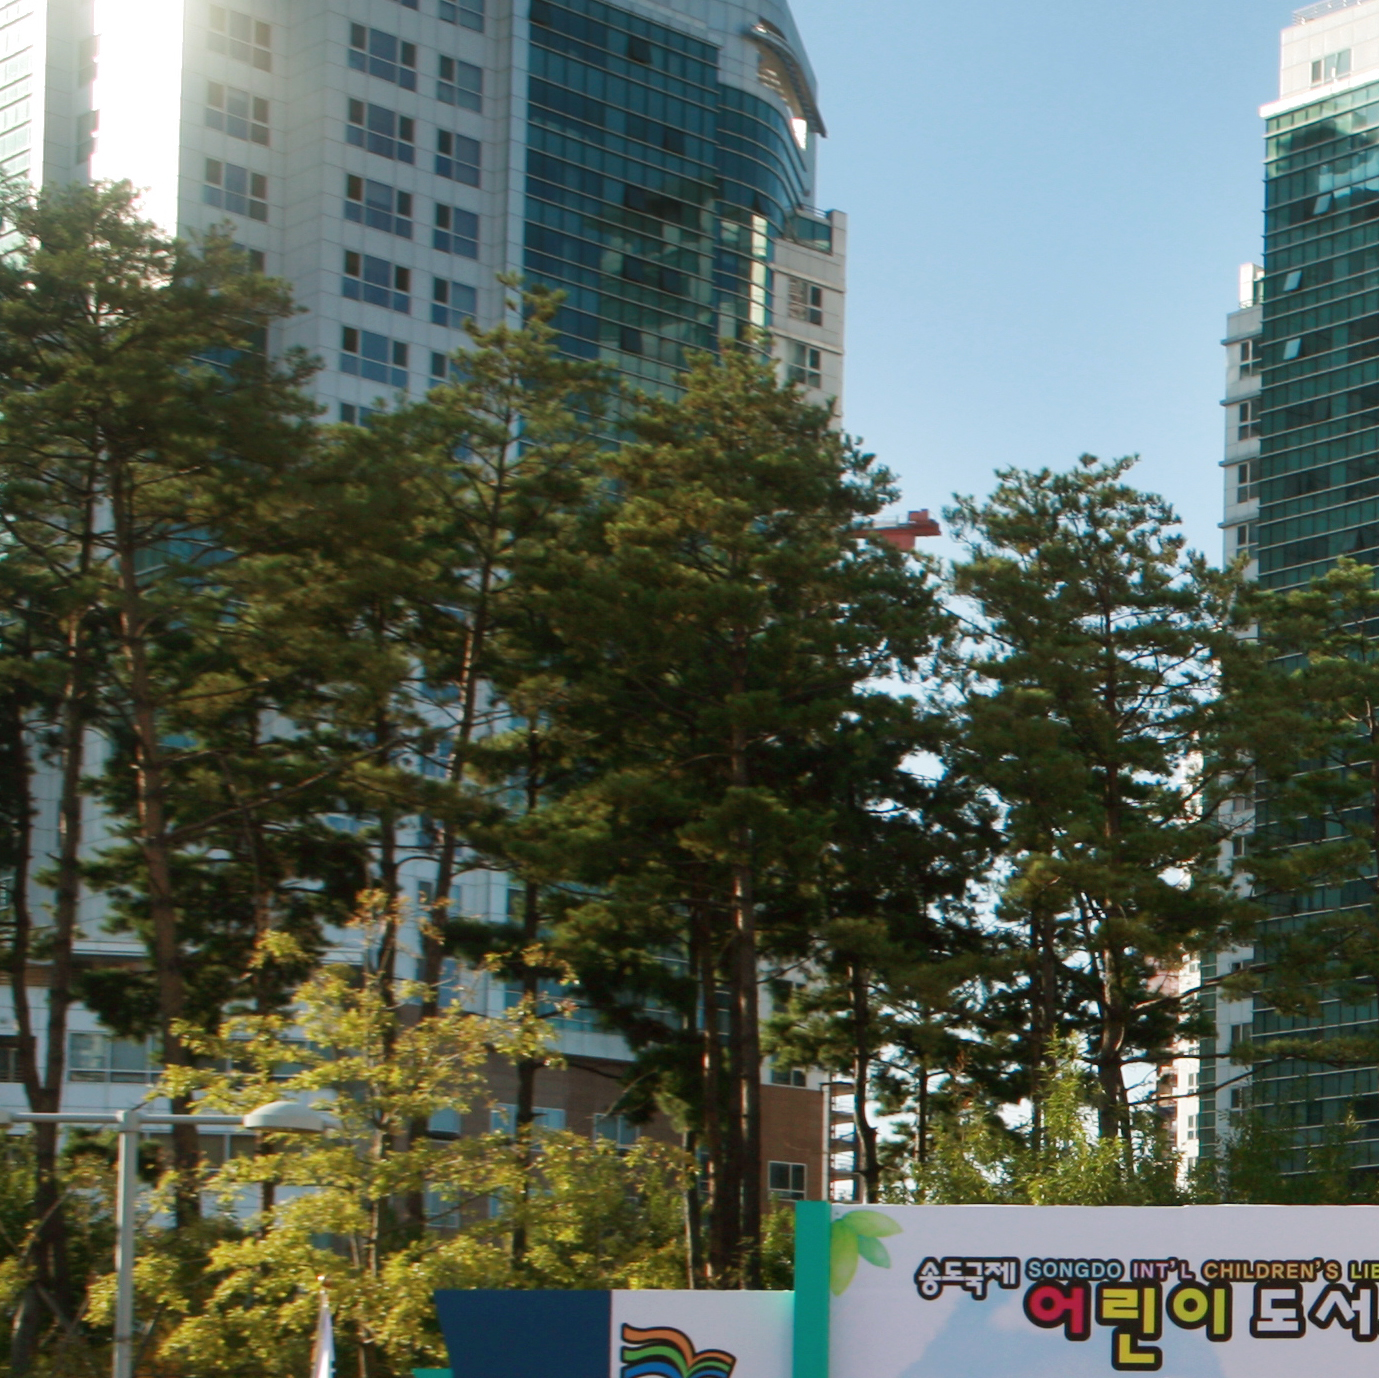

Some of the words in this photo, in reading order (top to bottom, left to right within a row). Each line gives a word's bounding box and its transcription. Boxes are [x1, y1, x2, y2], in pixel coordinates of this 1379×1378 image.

[917, 1260, 1018, 1297] 송도국제
[1028, 1260, 1122, 1279] SONGDO
[1133, 1260, 1193, 1280] INT'L
[1203, 1259, 1339, 1280] CHILDREN'S
[1029, 1286, 1225, 1364] 어린이
